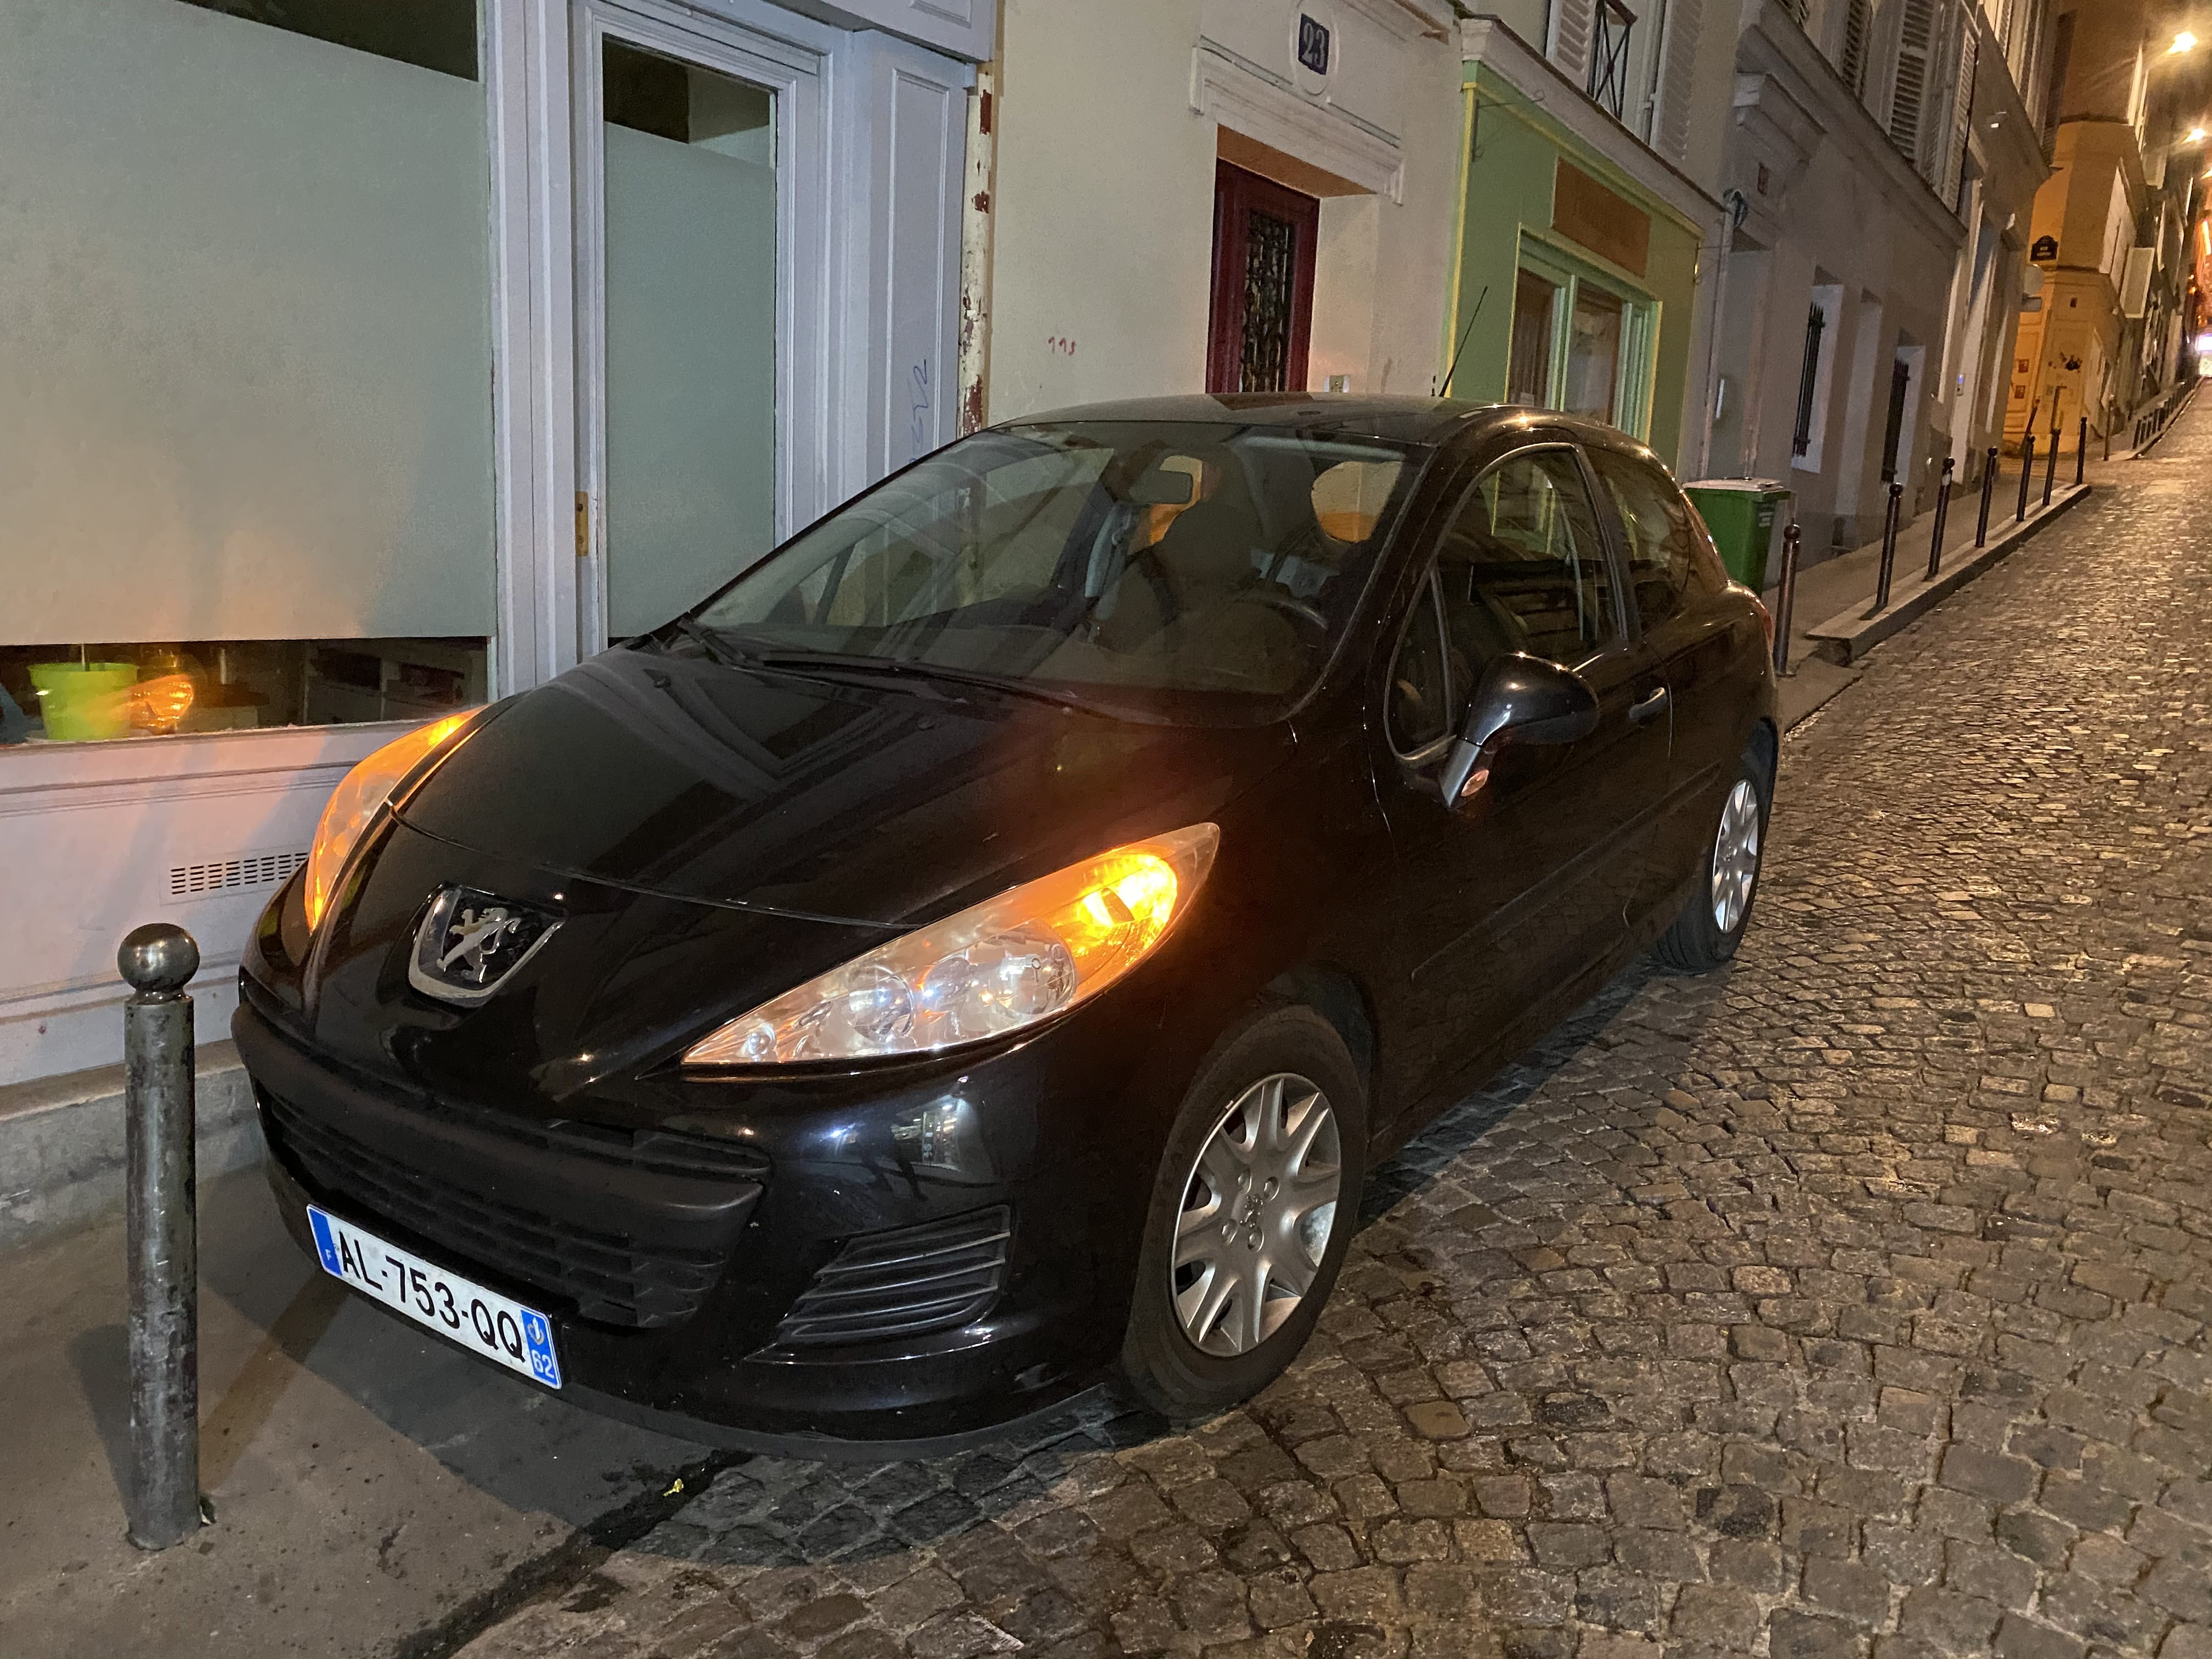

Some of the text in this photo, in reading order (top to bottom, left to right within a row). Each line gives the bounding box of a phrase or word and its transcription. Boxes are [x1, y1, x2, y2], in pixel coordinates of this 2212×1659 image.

[1301, 22, 1325, 68] 23
[325, 1249, 331, 1261] F
[338, 1229, 526, 1363] AL-753-QQ
[531, 1349, 555, 1379] 62
